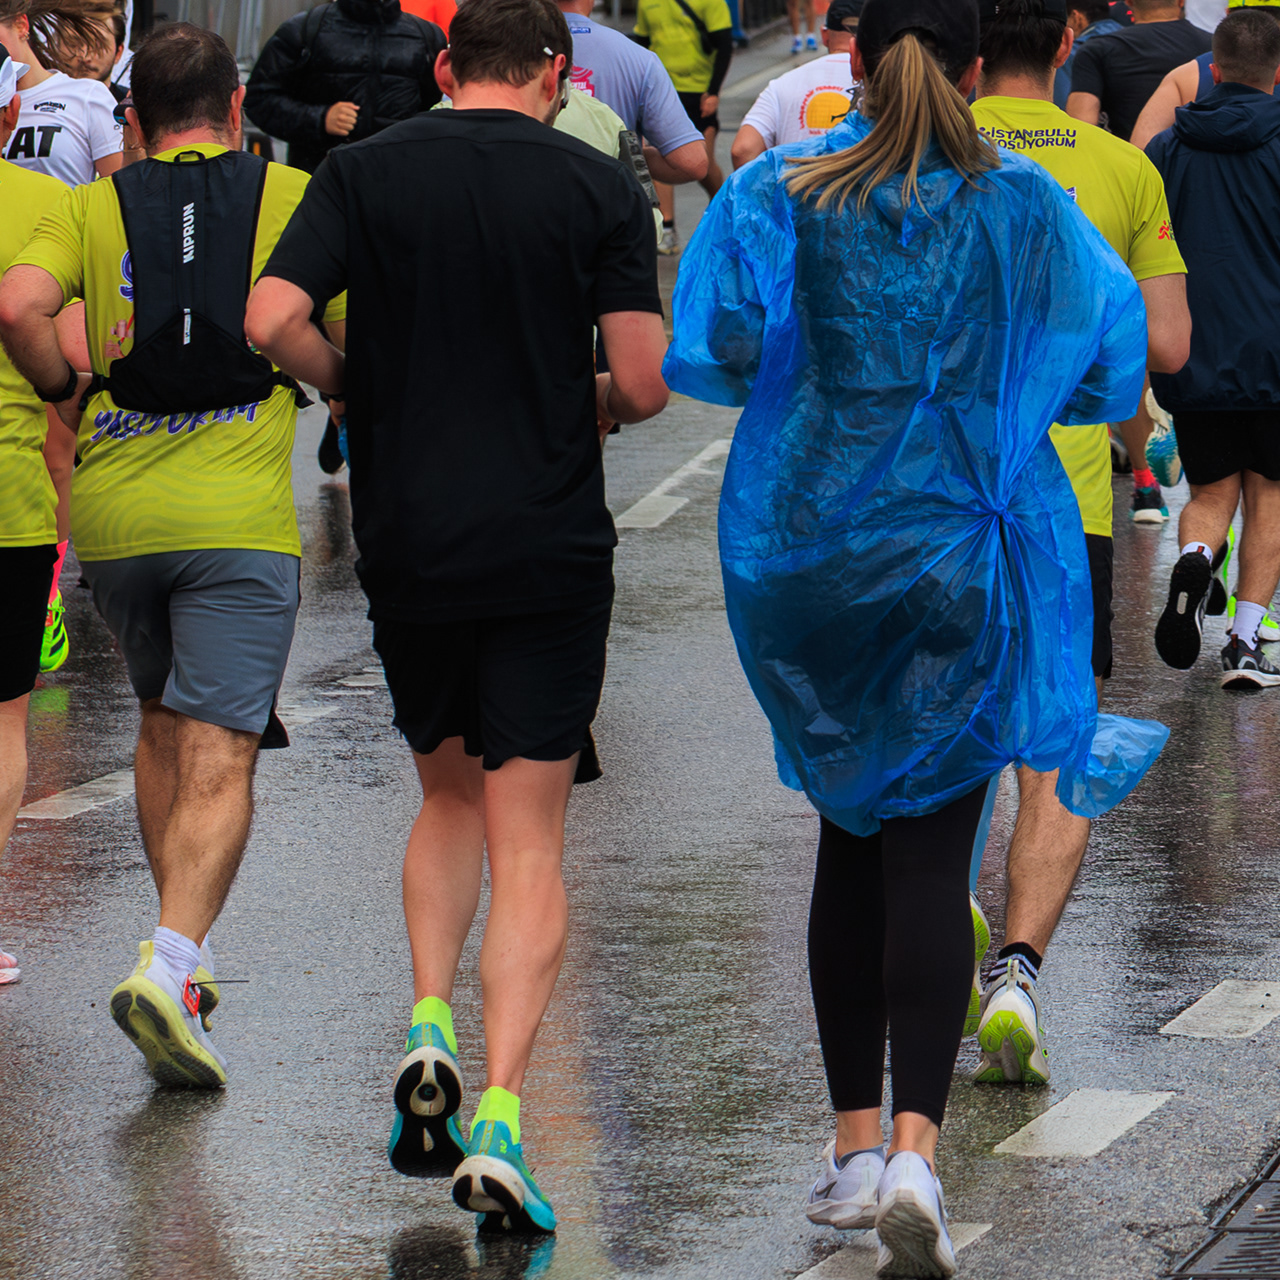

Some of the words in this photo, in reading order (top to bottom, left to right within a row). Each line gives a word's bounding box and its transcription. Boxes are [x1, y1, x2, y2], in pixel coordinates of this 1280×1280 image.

[2, 125, 62, 160] AT
[991, 127, 1077, 140] İSTANBULU
[182, 202, 195, 264] KIPRUN
